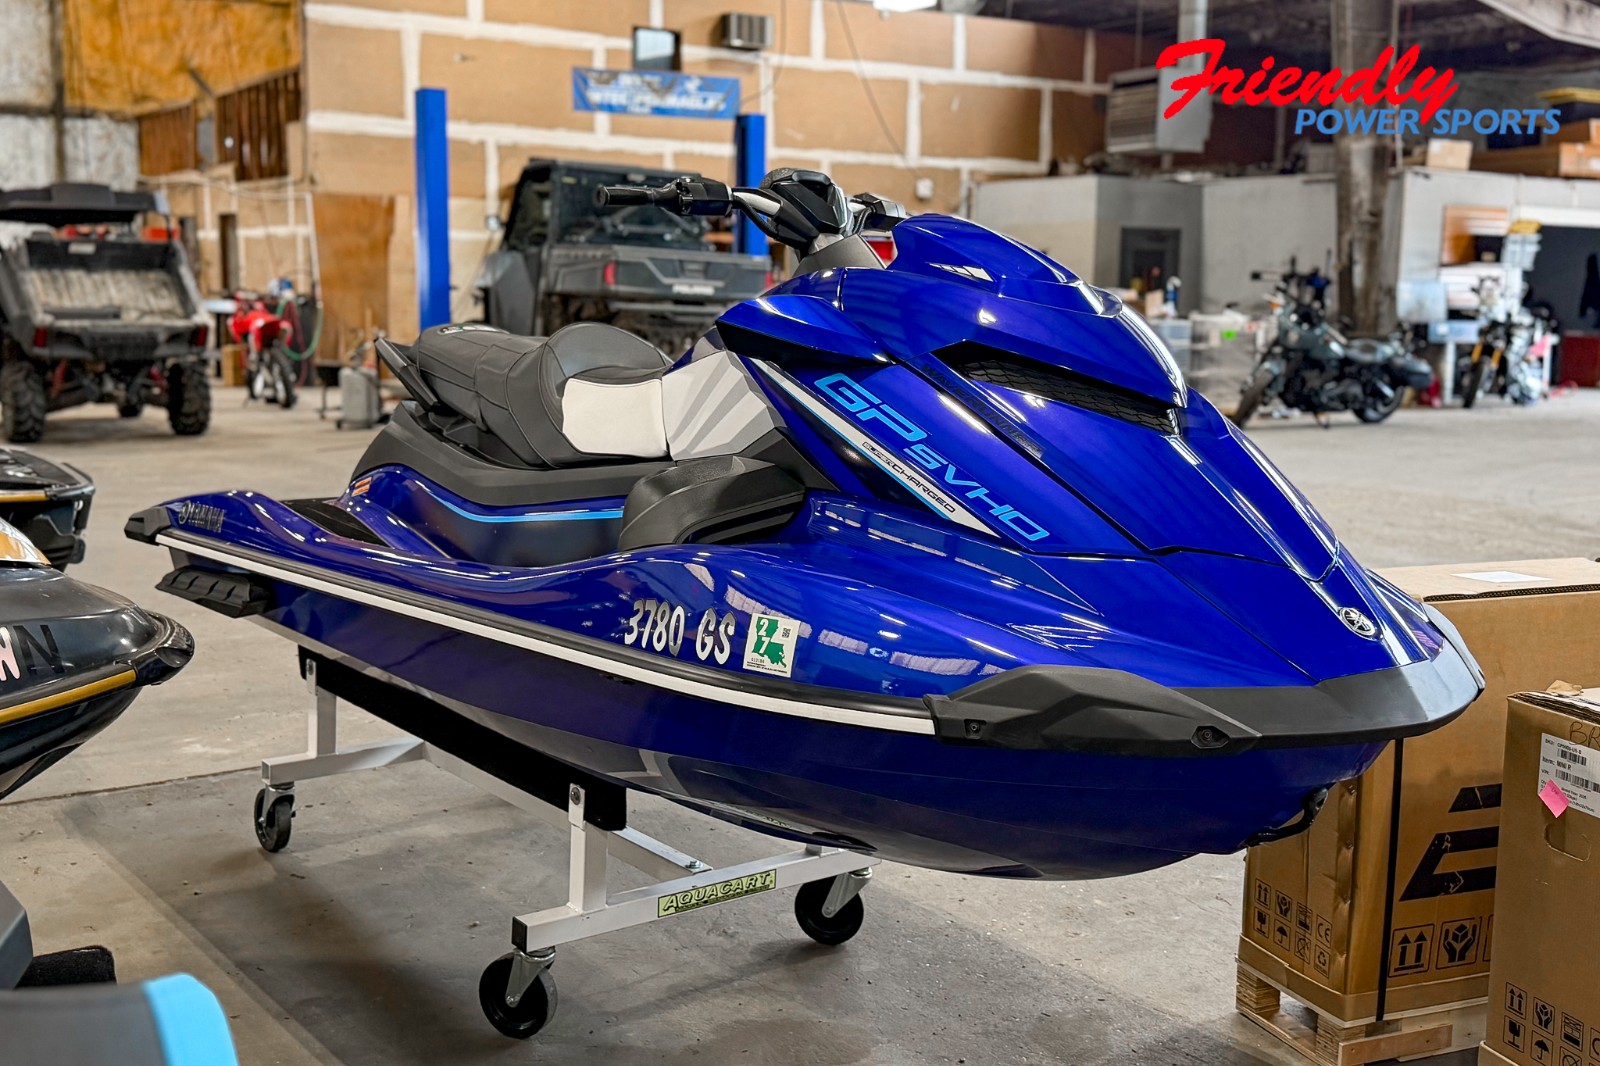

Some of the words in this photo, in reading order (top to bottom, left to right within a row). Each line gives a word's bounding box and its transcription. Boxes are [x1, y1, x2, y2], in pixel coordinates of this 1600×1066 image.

[814, 373, 928, 442] GP
[903, 443, 1050, 542] SVHO
[862, 441, 956, 513] SUPERCHARGED
[624, 598, 686, 657] 3780
[695, 607, 737, 665] GS
[662, 872, 771, 912] AQUACART
